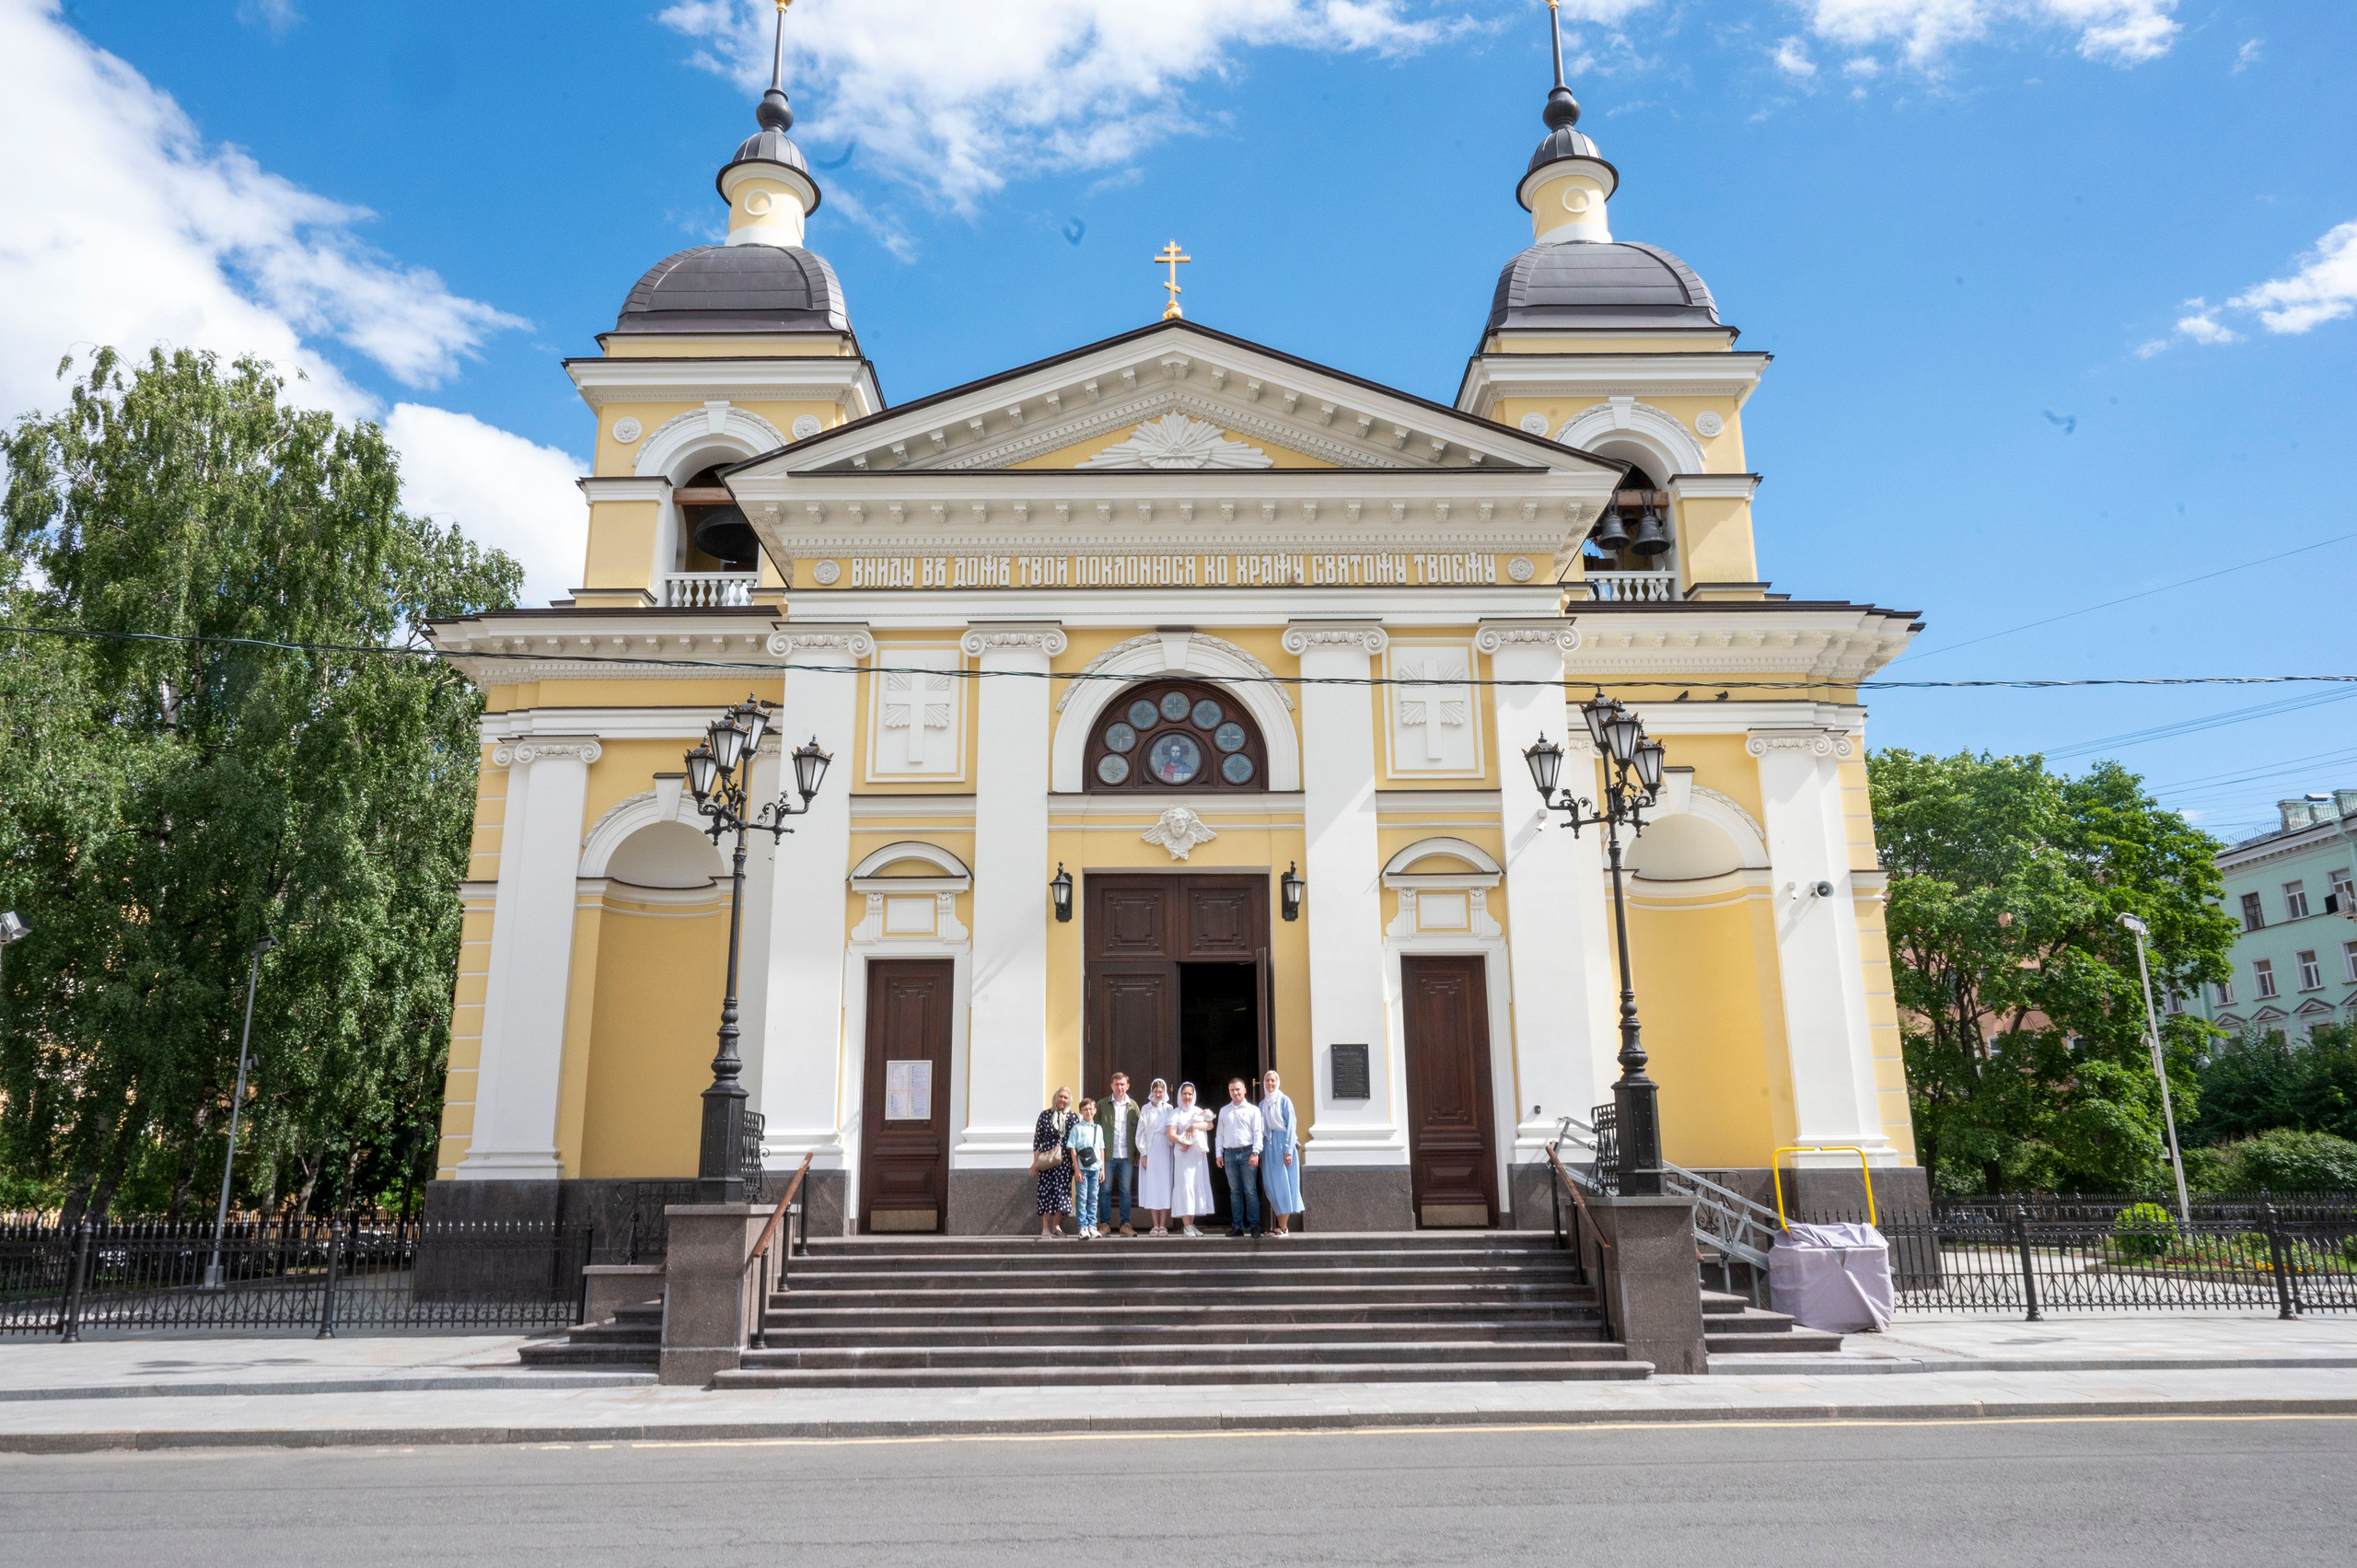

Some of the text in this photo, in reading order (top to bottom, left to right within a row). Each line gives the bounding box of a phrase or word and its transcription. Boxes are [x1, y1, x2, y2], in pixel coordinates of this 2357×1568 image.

[1018, 556, 1068, 586] ТВОЙ
[1075, 555, 1196, 586] ПОКЛОНЮСЯ
[1204, 555, 1228, 585] КО
[1237, 552, 1305, 585] ХРАМУ
[1312, 552, 1406, 584] СВЯТОМУ
[1413, 552, 1496, 584] ТВОЕМУ
